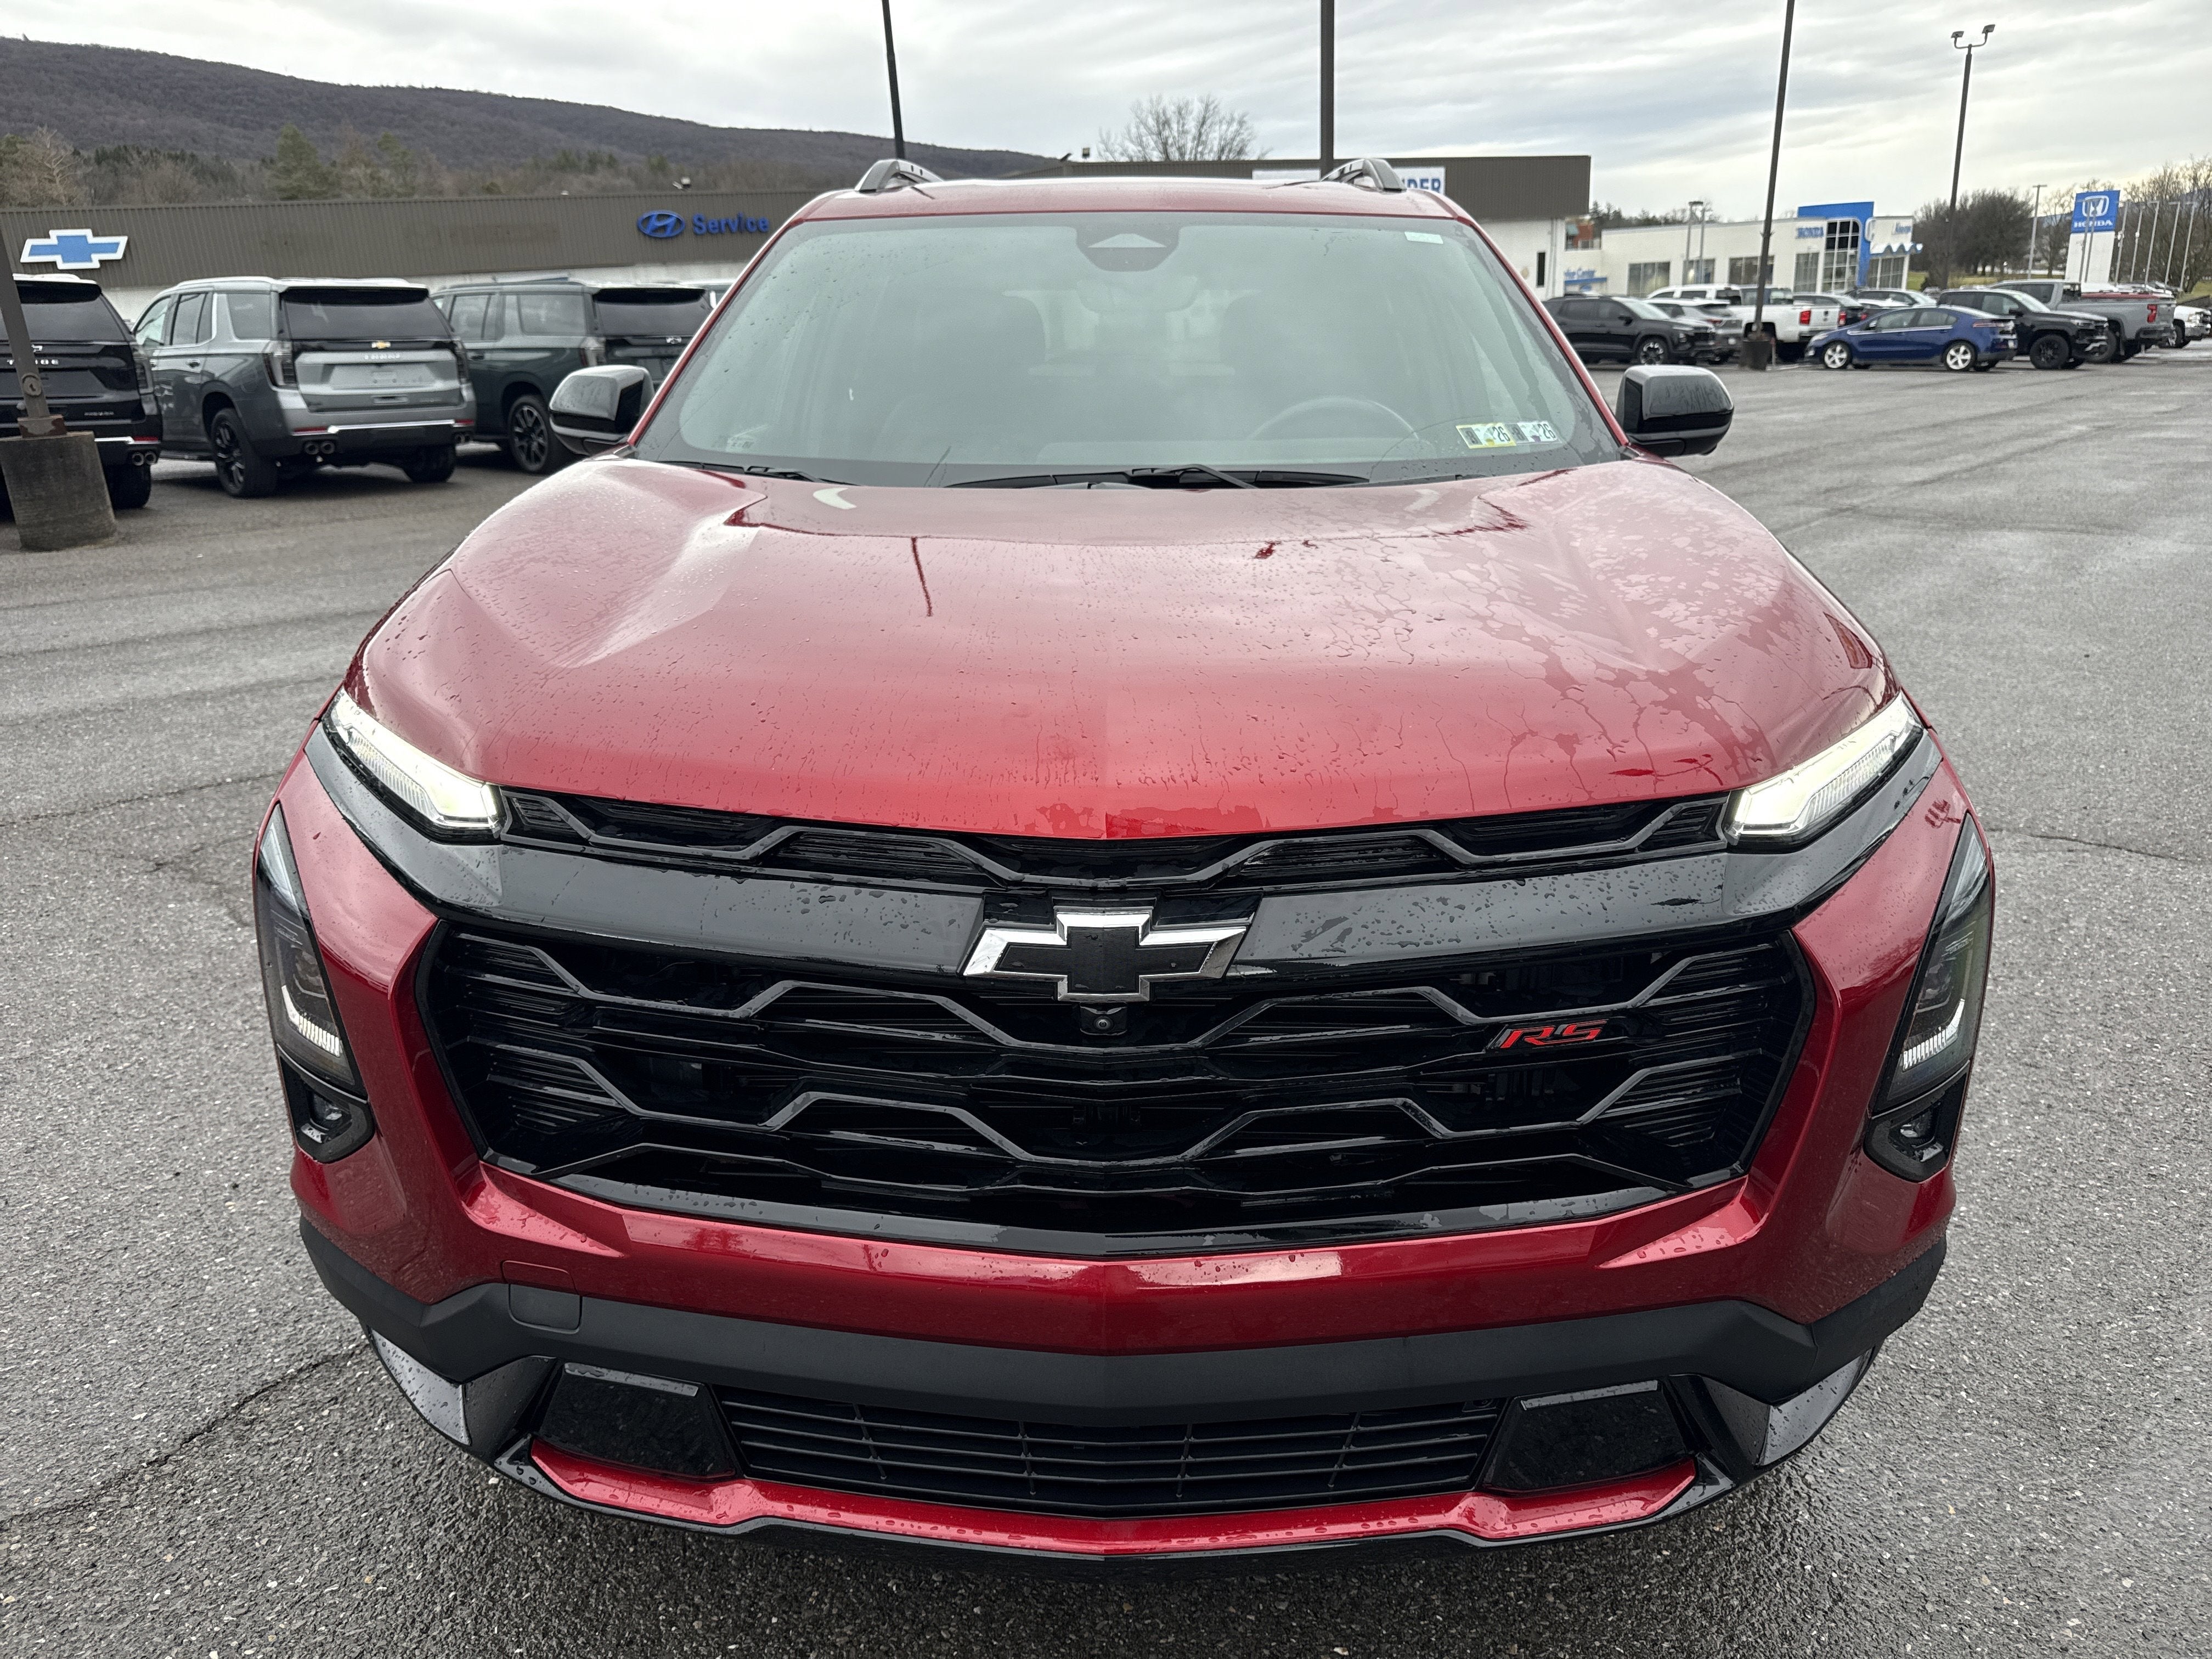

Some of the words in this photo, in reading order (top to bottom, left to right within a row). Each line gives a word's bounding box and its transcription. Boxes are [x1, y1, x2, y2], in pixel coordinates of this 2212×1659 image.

[692, 212, 770, 235] Service
[1492, 426, 1511, 442] 26
[1537, 423, 1556, 439] 26
[1499, 1019, 1608, 1049] RS
